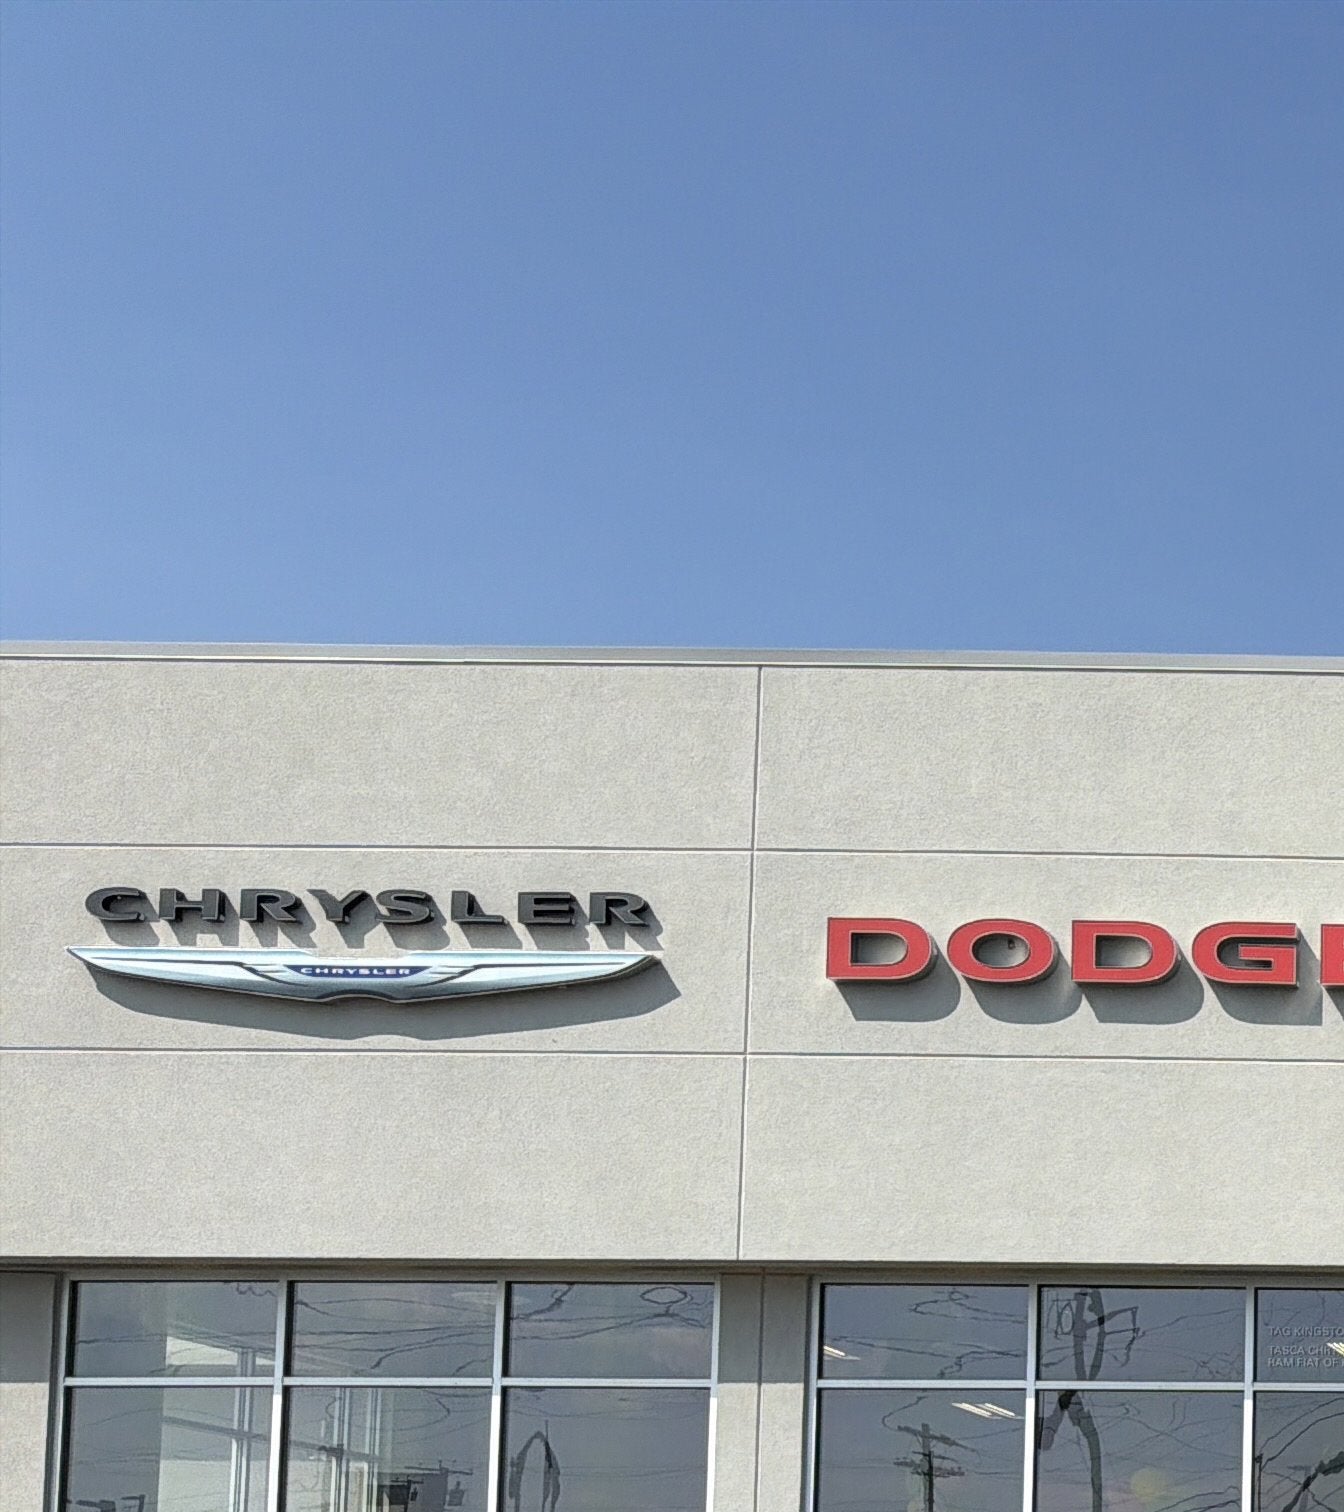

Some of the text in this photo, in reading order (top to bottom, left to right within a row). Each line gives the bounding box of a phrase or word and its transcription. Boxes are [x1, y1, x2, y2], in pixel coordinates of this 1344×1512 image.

[85, 886, 652, 926] CHRYSLER
[300, 967, 410, 975] CHRYSLER
[1267, 1327, 1291, 1336] TAG
[1268, 1346, 1305, 1356] TASCA
[1296, 1357, 1319, 1367] FIAT
[1323, 1357, 1338, 1367] OF
